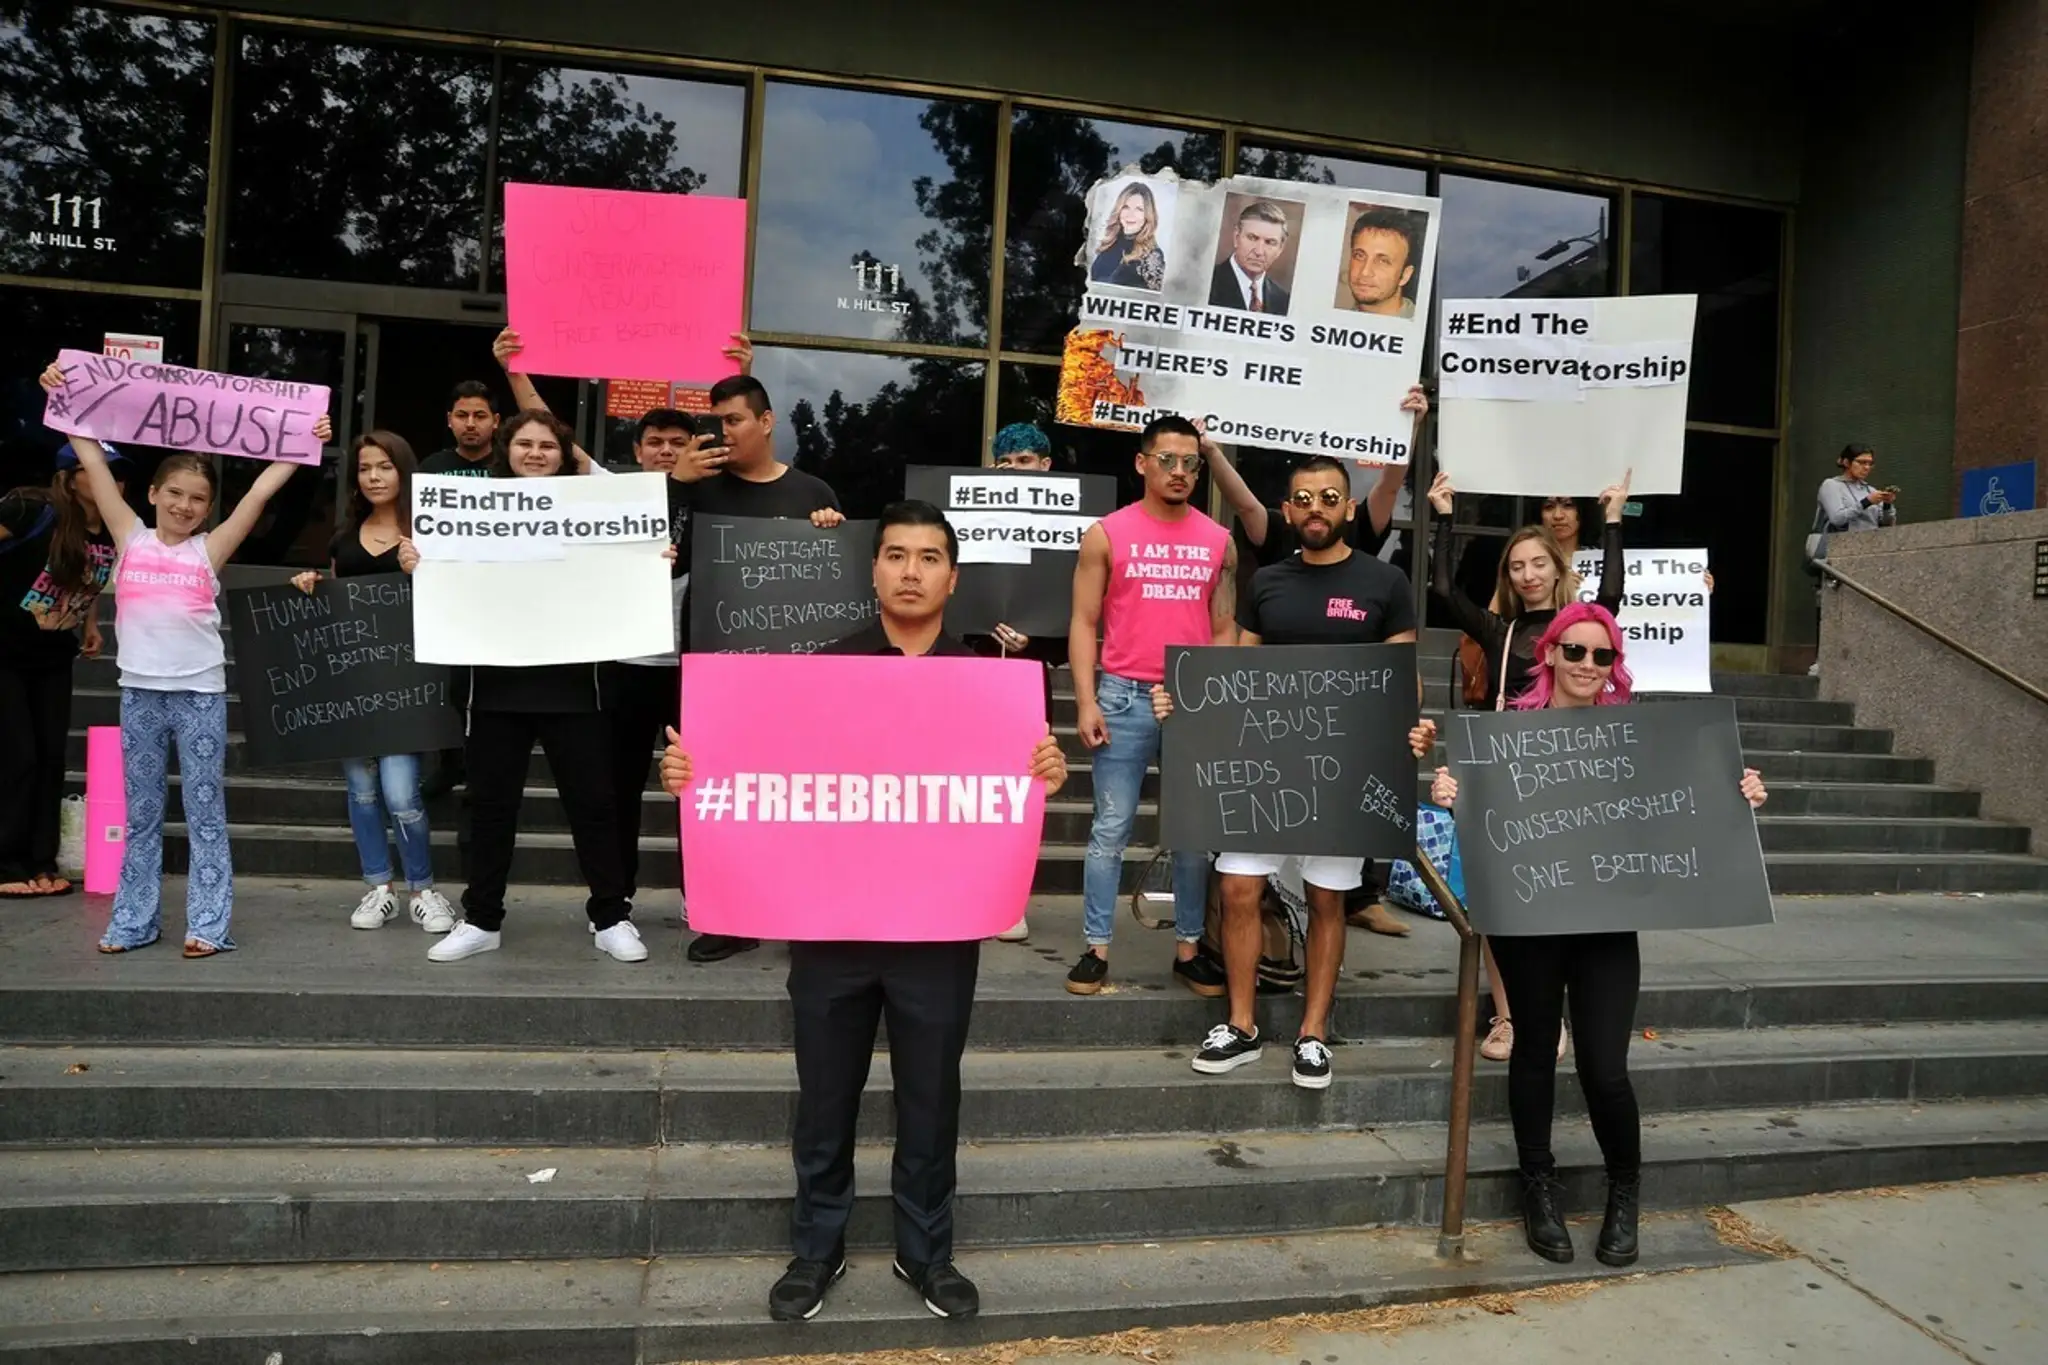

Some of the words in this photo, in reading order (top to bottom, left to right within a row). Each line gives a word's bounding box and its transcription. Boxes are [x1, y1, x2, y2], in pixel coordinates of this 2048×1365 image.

[44, 192, 101, 229] 111
[570, 193, 666, 237] STOP
[49, 233, 87, 249] HILL
[93, 237, 117, 252] ST.
[849, 260, 900, 295] 111
[853, 299, 885, 312] HILL
[891, 301, 912, 315] ST.
[1085, 296, 1179, 326] WHERE
[1188, 309, 1296, 342] THERE'S
[1310, 325, 1404, 355] SMOKE
[1448, 313, 1521, 335] #End
[1531, 313, 1589, 335] The
[552, 320, 604, 349] FREE
[1119, 348, 1229, 377] THERE'S
[1243, 362, 1304, 386] FIRE
[1440, 351, 1687, 382] Conservatorship
[132, 391, 313, 458] ABUSE
[418, 486, 554, 511] #EndThe
[955, 486, 1019, 505] #End
[1028, 487, 1075, 507] The
[413, 513, 667, 539] Conservatorship
[711, 524, 842, 564] INVESTIGATE
[1129, 543, 1138, 558] I
[1143, 544, 1170, 559] AM
[1173, 544, 1211, 562] THE
[1651, 558, 1703, 576] The
[740, 562, 842, 590] BRITNEY'S
[1124, 562, 1214, 583] AMERICAN
[247, 590, 331, 635] HUMAN
[346, 582, 412, 611] RIGH
[1141, 583, 1201, 600] DREAM
[1328, 597, 1353, 609] FREE
[715, 598, 881, 635] CONSERVATORSHI
[1326, 607, 1368, 622] BRITNEY
[293, 613, 380, 660] MATTER!
[266, 663, 318, 696] END
[1174, 650, 1394, 713] CONSERVATORSHIP
[271, 681, 445, 736] CONSERVATORSHIP!
[1237, 705, 1346, 748] ABUSE
[1456, 713, 1639, 765] INVESTIGATE
[1195, 759, 1282, 788] NEEDS
[1304, 754, 1342, 781] TO
[1508, 755, 1636, 802] BRITNEY'S
[694, 771, 1034, 825] #FREEBRITNEY
[1218, 785, 1319, 836] END!
[1361, 773, 1400, 811] FREE
[1359, 792, 1412, 833] BRITNEY
[1484, 785, 1697, 854] CONSERVATORSHIP!
[1511, 860, 1575, 904] SAVE
[1590, 846, 1700, 885] BRITNEY!
